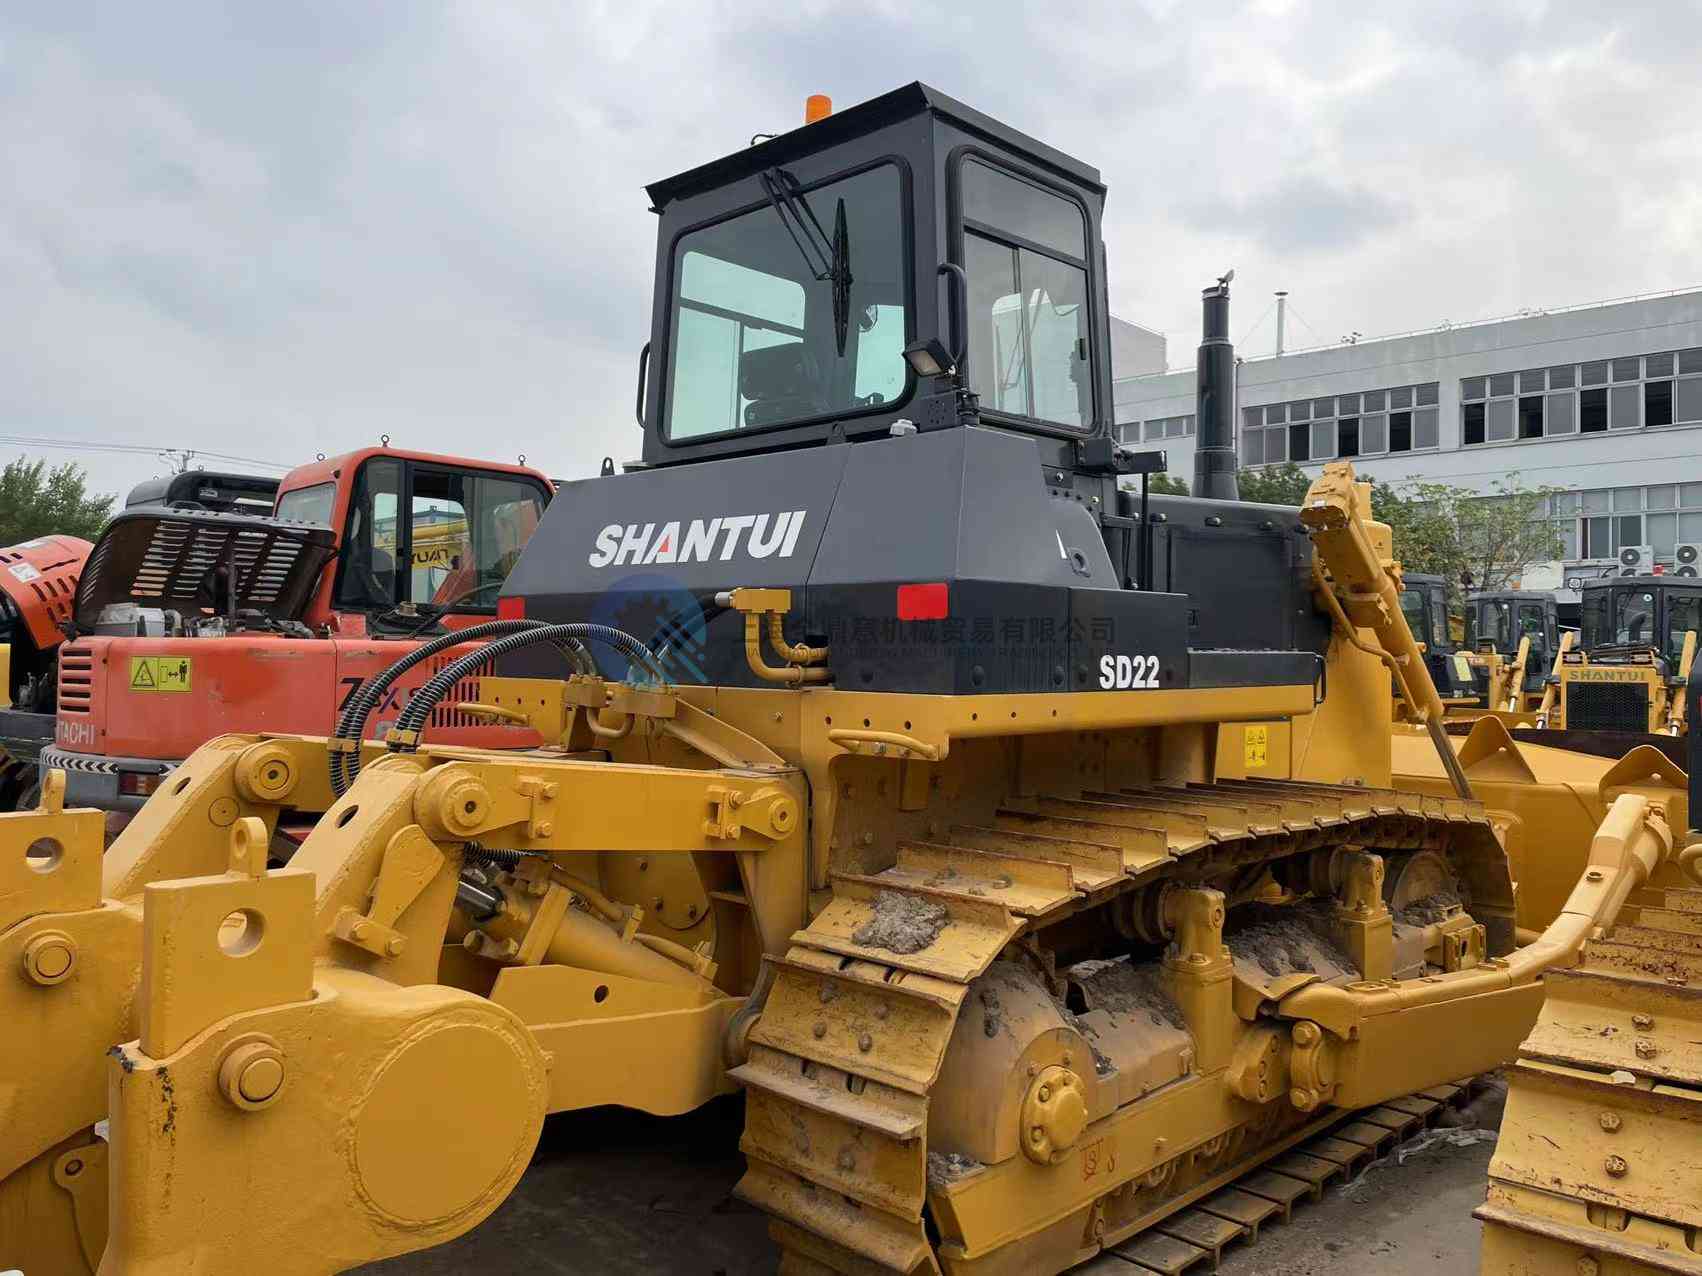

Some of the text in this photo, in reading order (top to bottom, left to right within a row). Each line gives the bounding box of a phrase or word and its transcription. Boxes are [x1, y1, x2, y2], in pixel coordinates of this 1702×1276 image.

[588, 510, 807, 568] SHANTUI
[1099, 654, 1160, 689] SD22
[1569, 670, 1646, 681] SHANTUI
